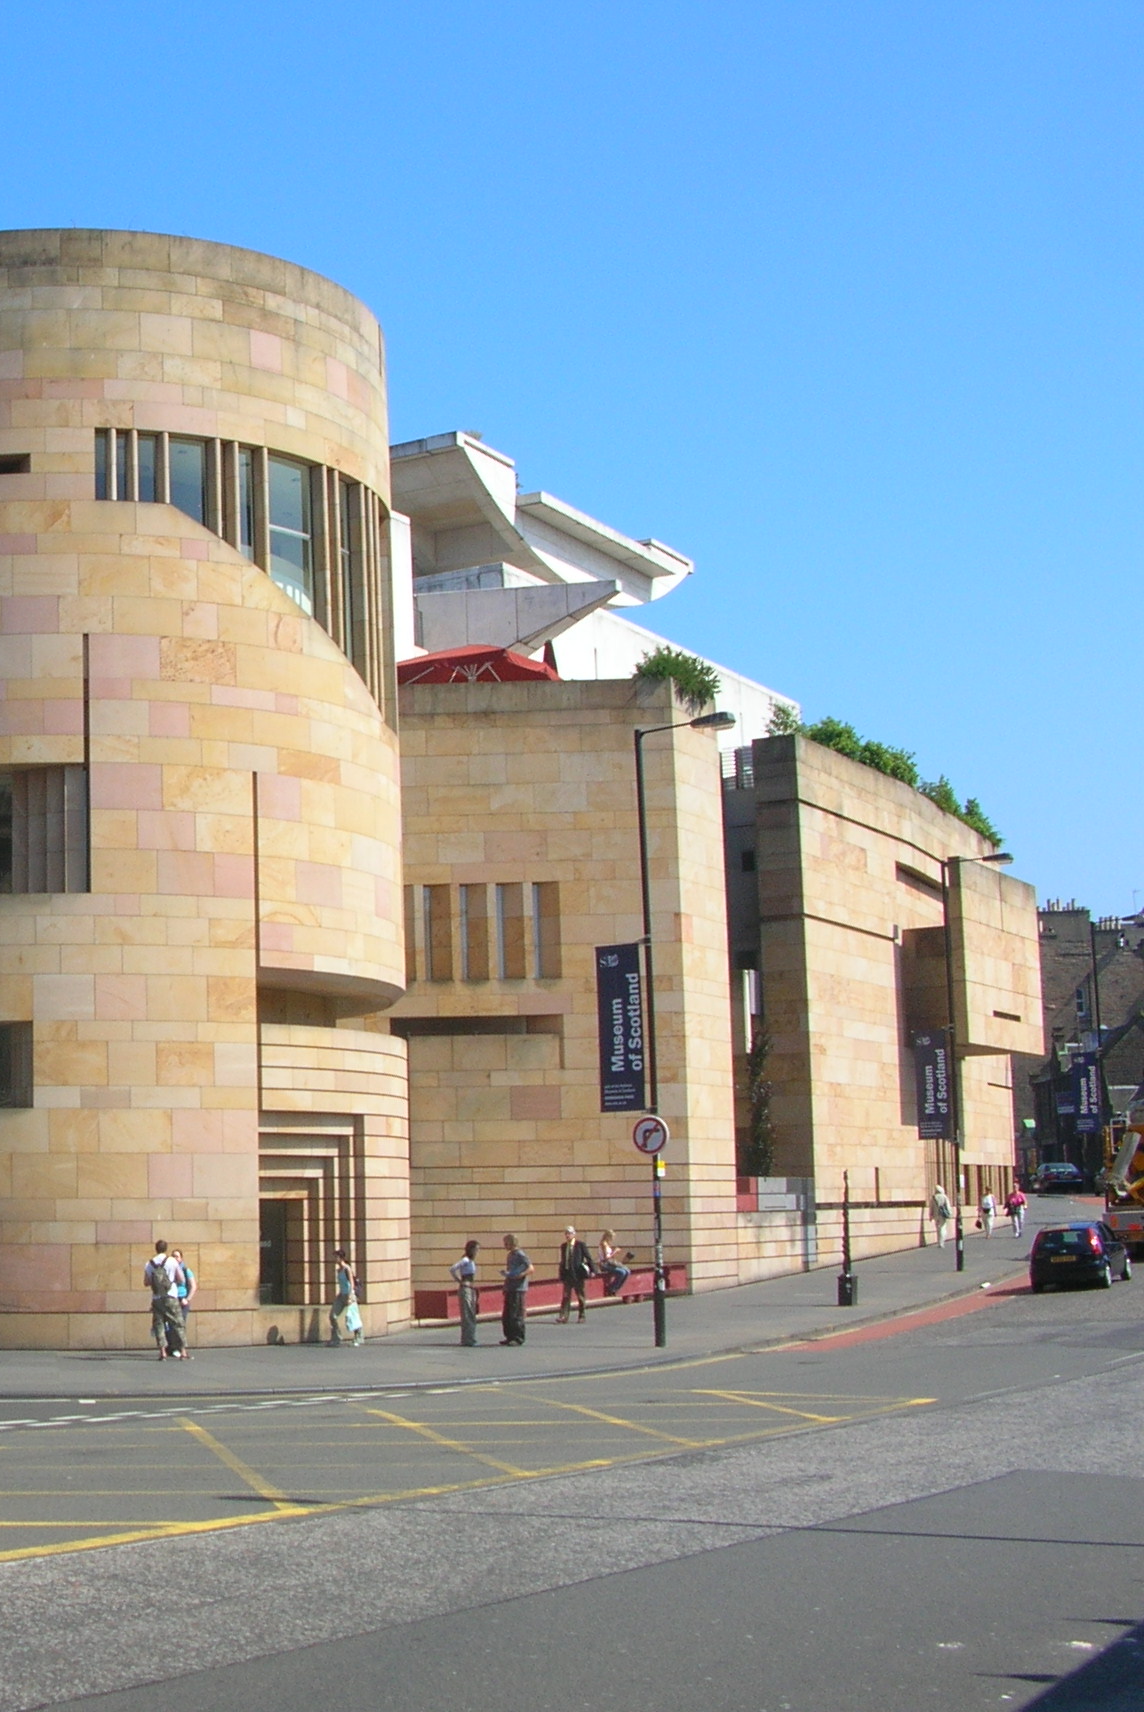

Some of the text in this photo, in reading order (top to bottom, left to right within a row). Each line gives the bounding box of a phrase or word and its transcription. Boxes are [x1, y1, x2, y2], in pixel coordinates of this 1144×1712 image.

[611, 998, 625, 1072] Museum
[625, 973, 643, 1071] of Scotland
[924, 1065, 935, 1114] Museum
[934, 1048, 948, 1114] of Scotland
[1080, 1077, 1089, 1114] Museum
